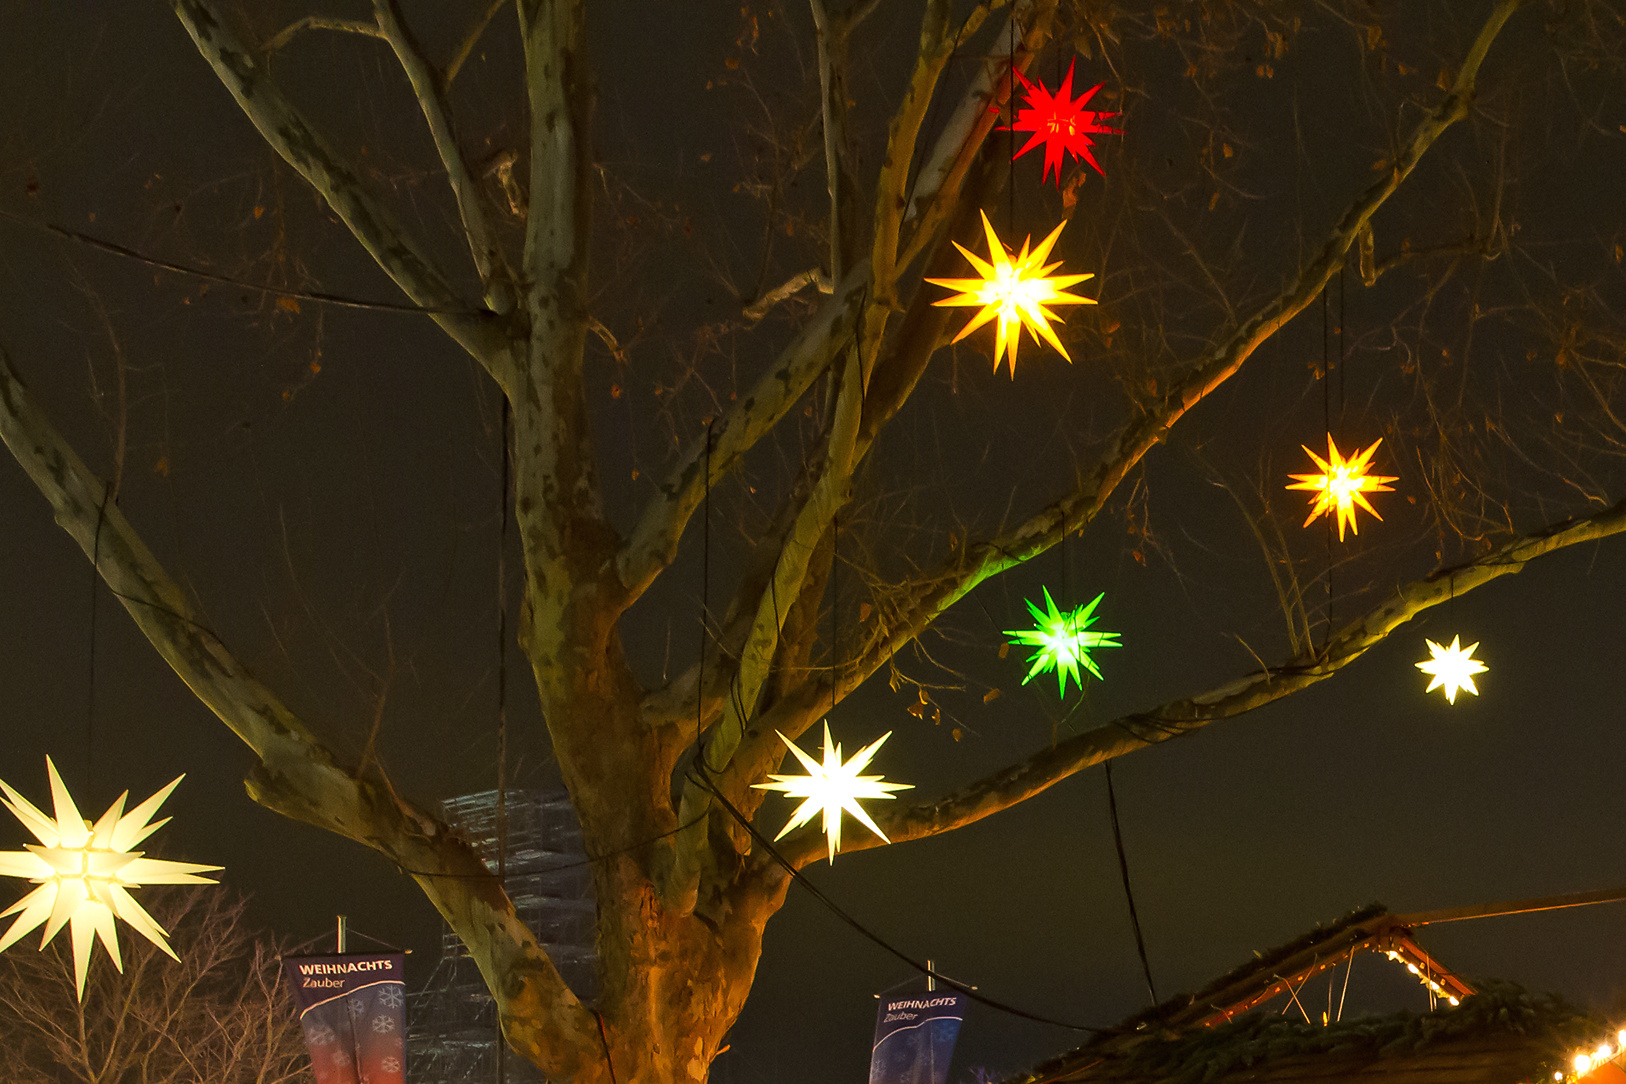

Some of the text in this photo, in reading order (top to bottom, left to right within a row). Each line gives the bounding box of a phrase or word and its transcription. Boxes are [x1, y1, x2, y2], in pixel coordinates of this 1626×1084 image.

[299, 960, 393, 975] WEIHNACHTS
[302, 977, 345, 988] Zauber
[888, 997, 957, 1011] WEIHNACHTS
[883, 1011, 919, 1023] Zauber
